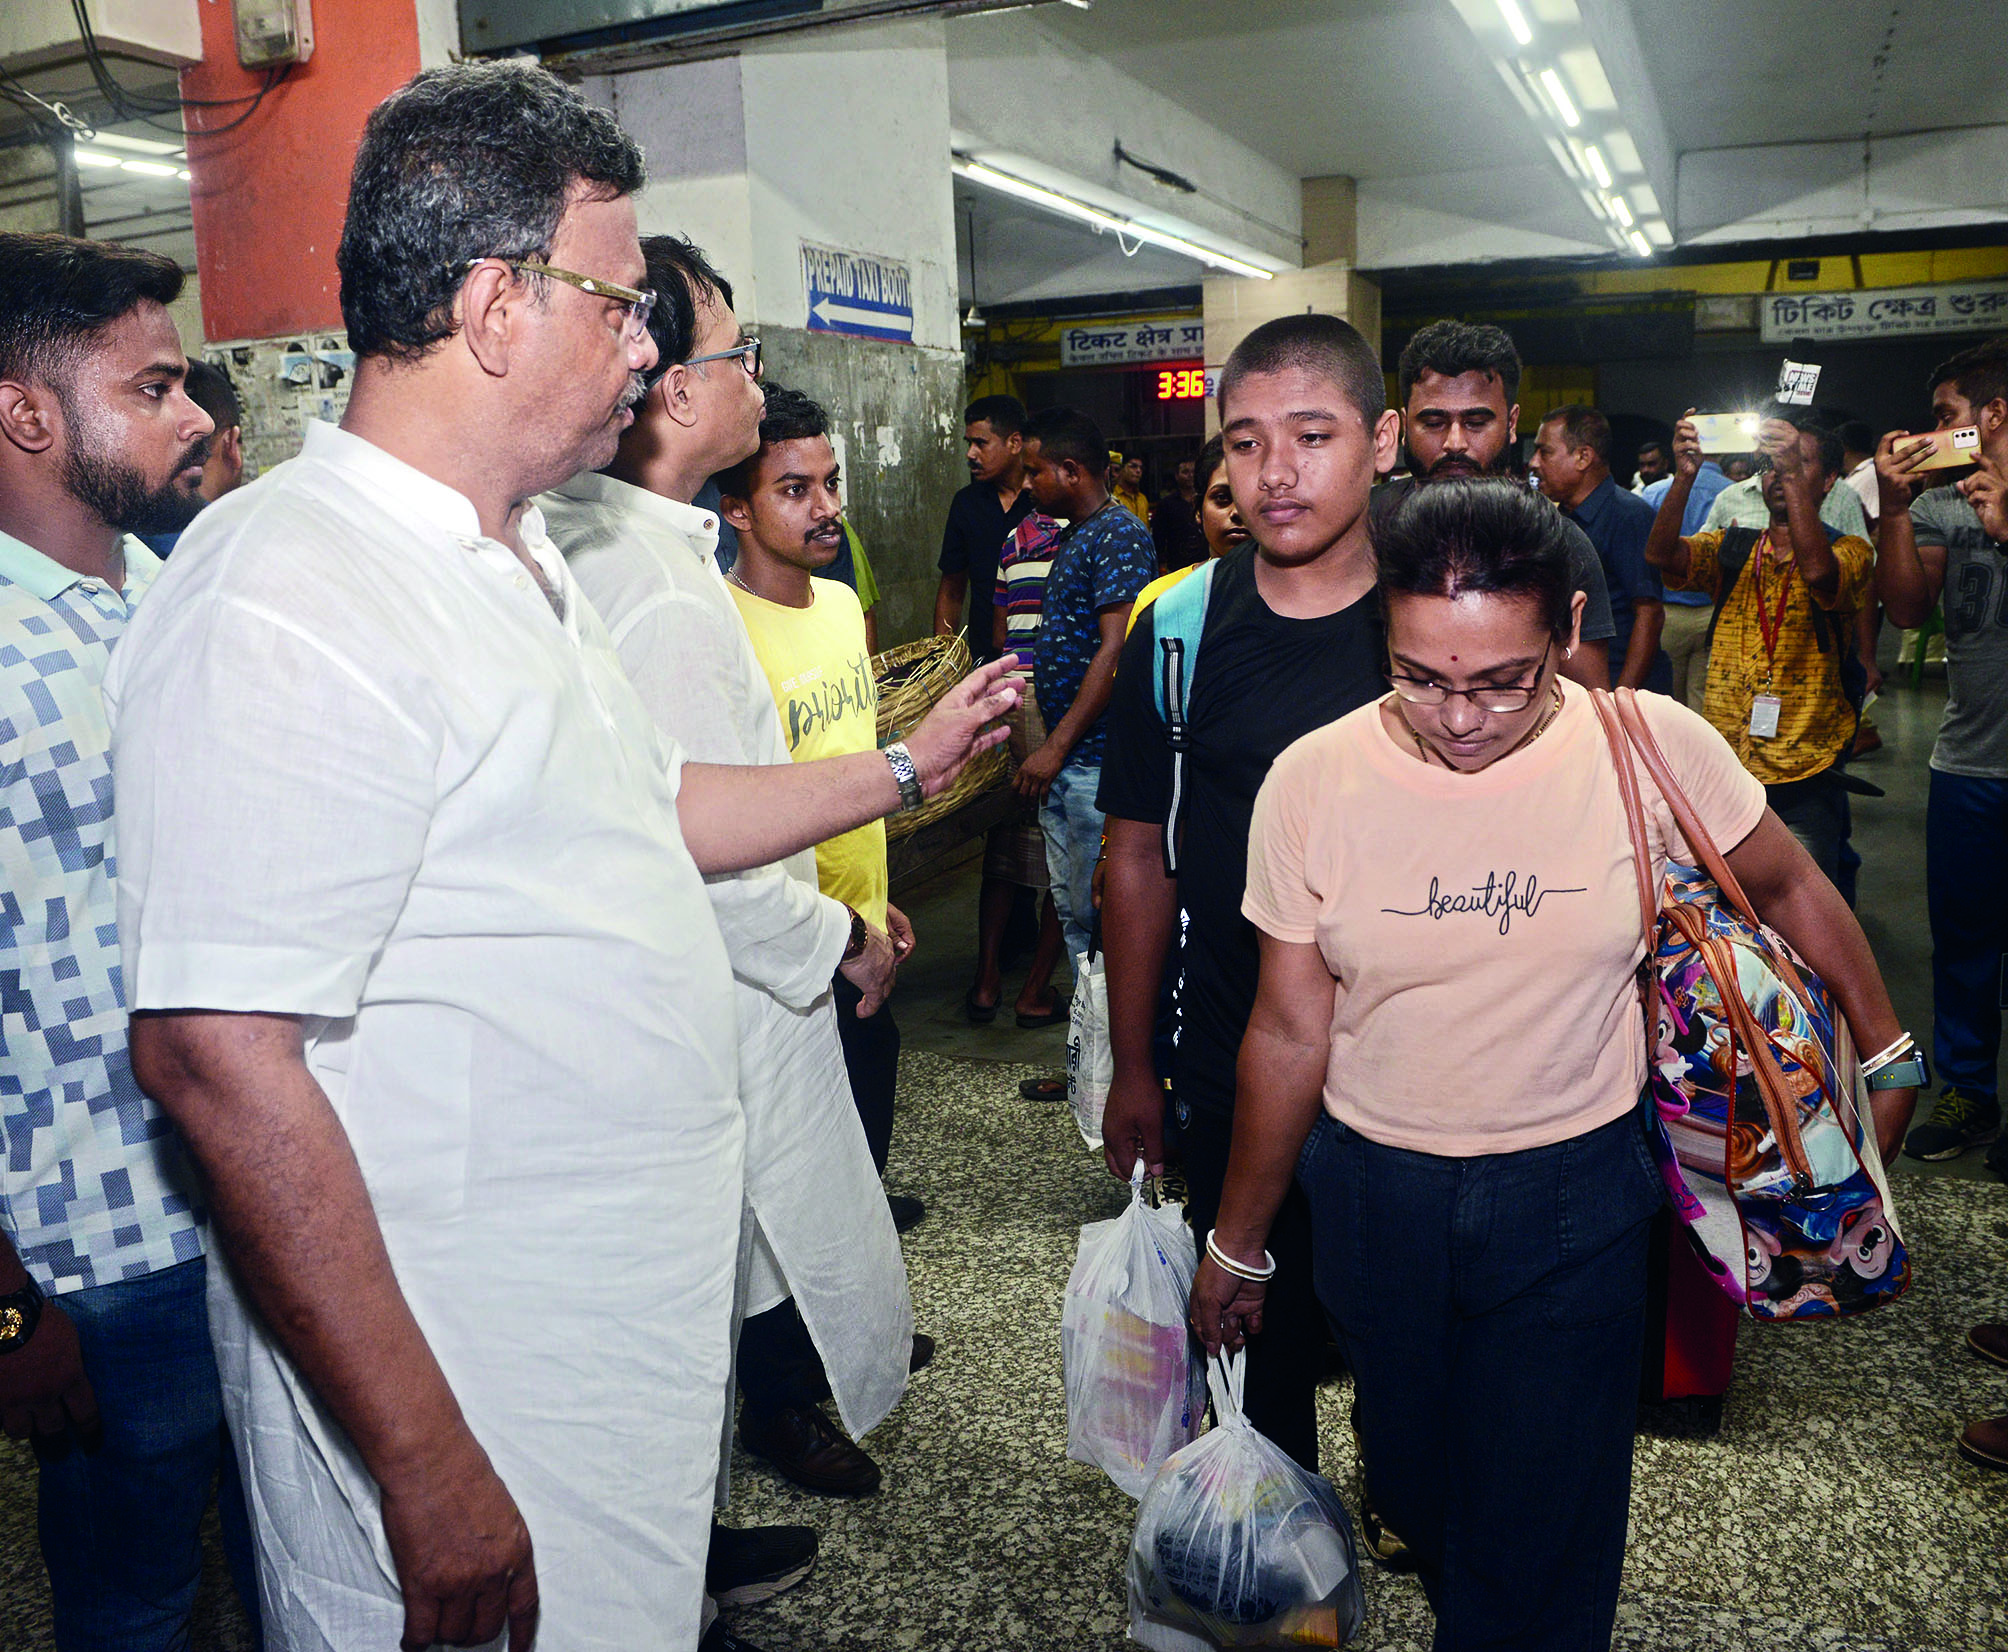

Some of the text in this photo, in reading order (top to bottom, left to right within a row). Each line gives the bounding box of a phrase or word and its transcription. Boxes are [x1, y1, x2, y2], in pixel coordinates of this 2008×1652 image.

[805, 248, 855, 298] PREPAID
[857, 259, 880, 303] TAXI
[1772, 295, 1855, 325] টিকিট
[1868, 295, 1937, 320] ক্ষেত্র
[1068, 325, 1204, 351] टिकट क्षेत्र प्रा
[1158, 370, 1204, 400] 3:36
[1380, 871, 1588, 936] beautiful
